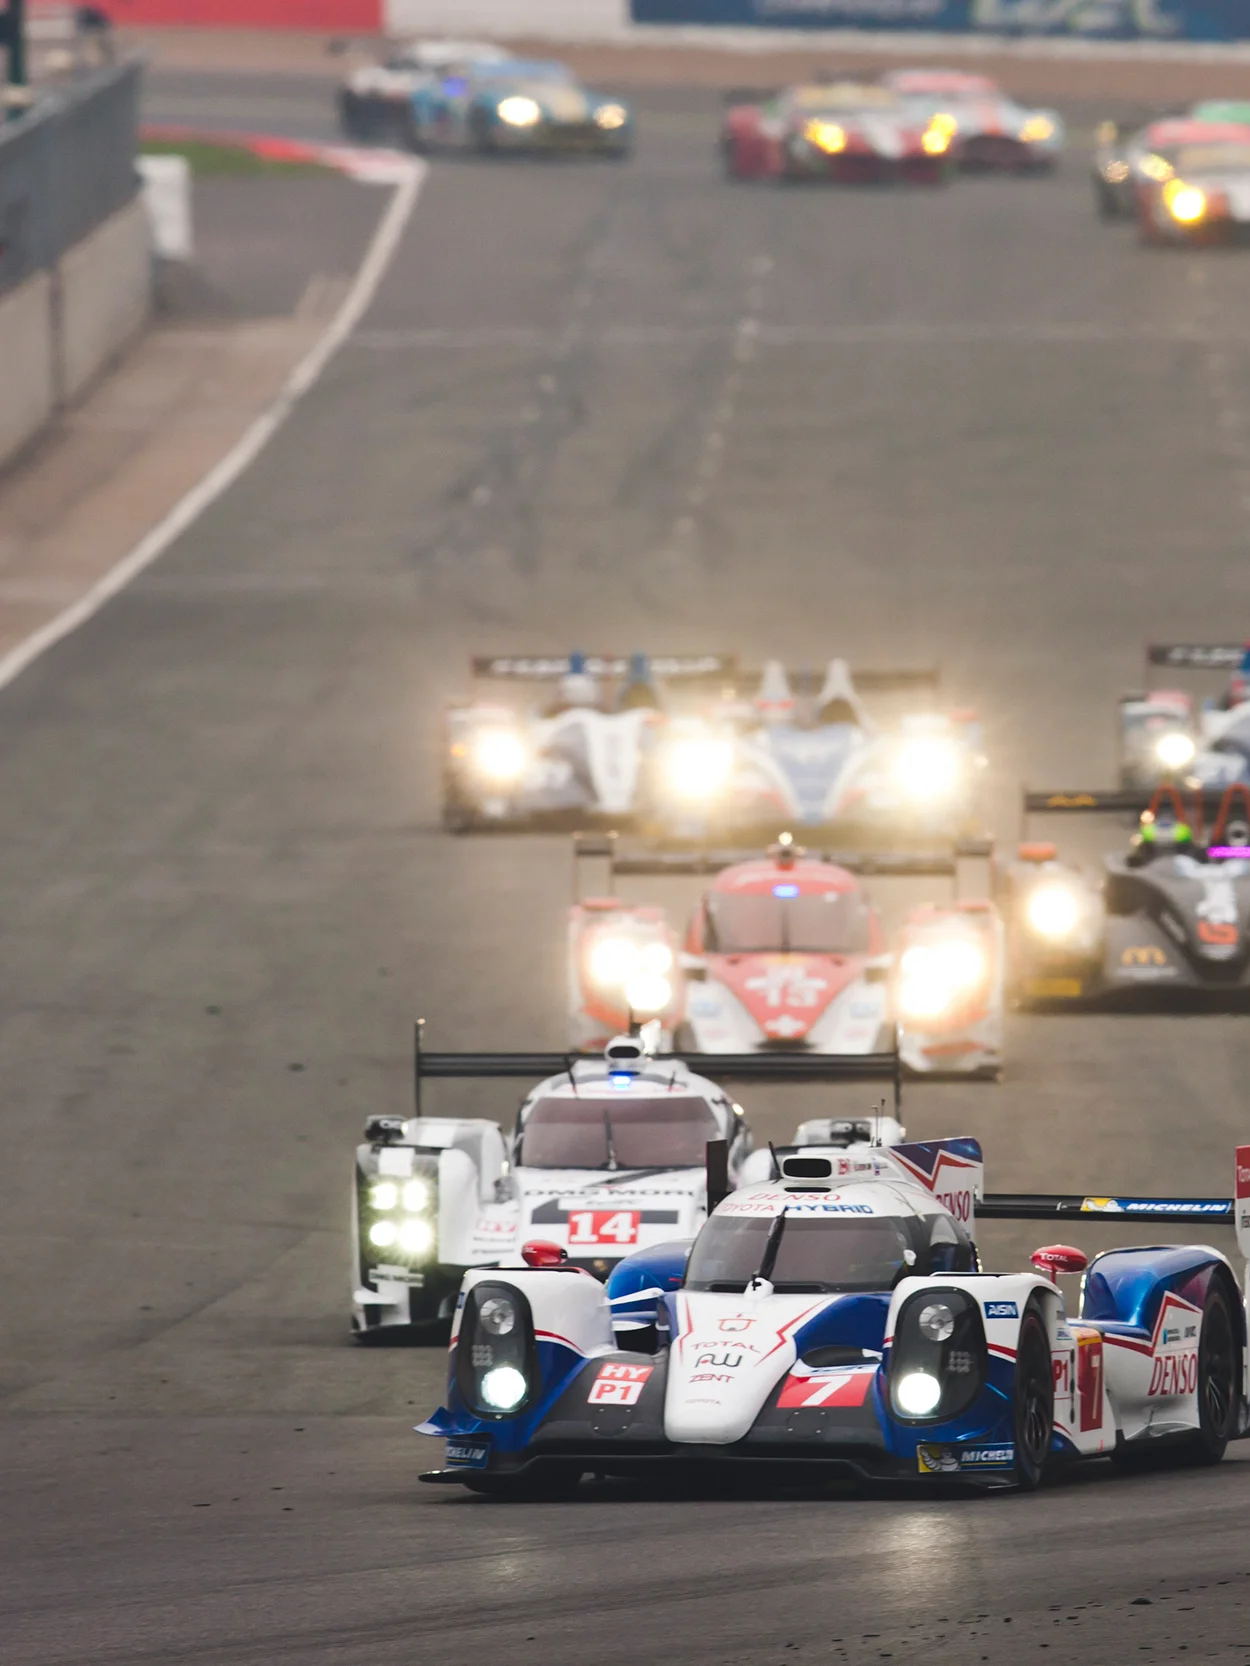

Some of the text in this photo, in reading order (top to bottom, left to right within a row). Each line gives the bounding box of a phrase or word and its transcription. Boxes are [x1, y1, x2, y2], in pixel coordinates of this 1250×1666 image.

[784, 1204, 873, 1214] HYBRID
[1126, 1203, 1227, 1212] MICHELIN
[570, 1212, 636, 1243] 14
[690, 1340, 761, 1354] TOTAL
[601, 1365, 650, 1379] HY
[688, 1373, 735, 1384] ZENT
[1147, 1353, 1198, 1396] DENSO
[595, 1383, 632, 1401] P1
[801, 1375, 853, 1406] 7
